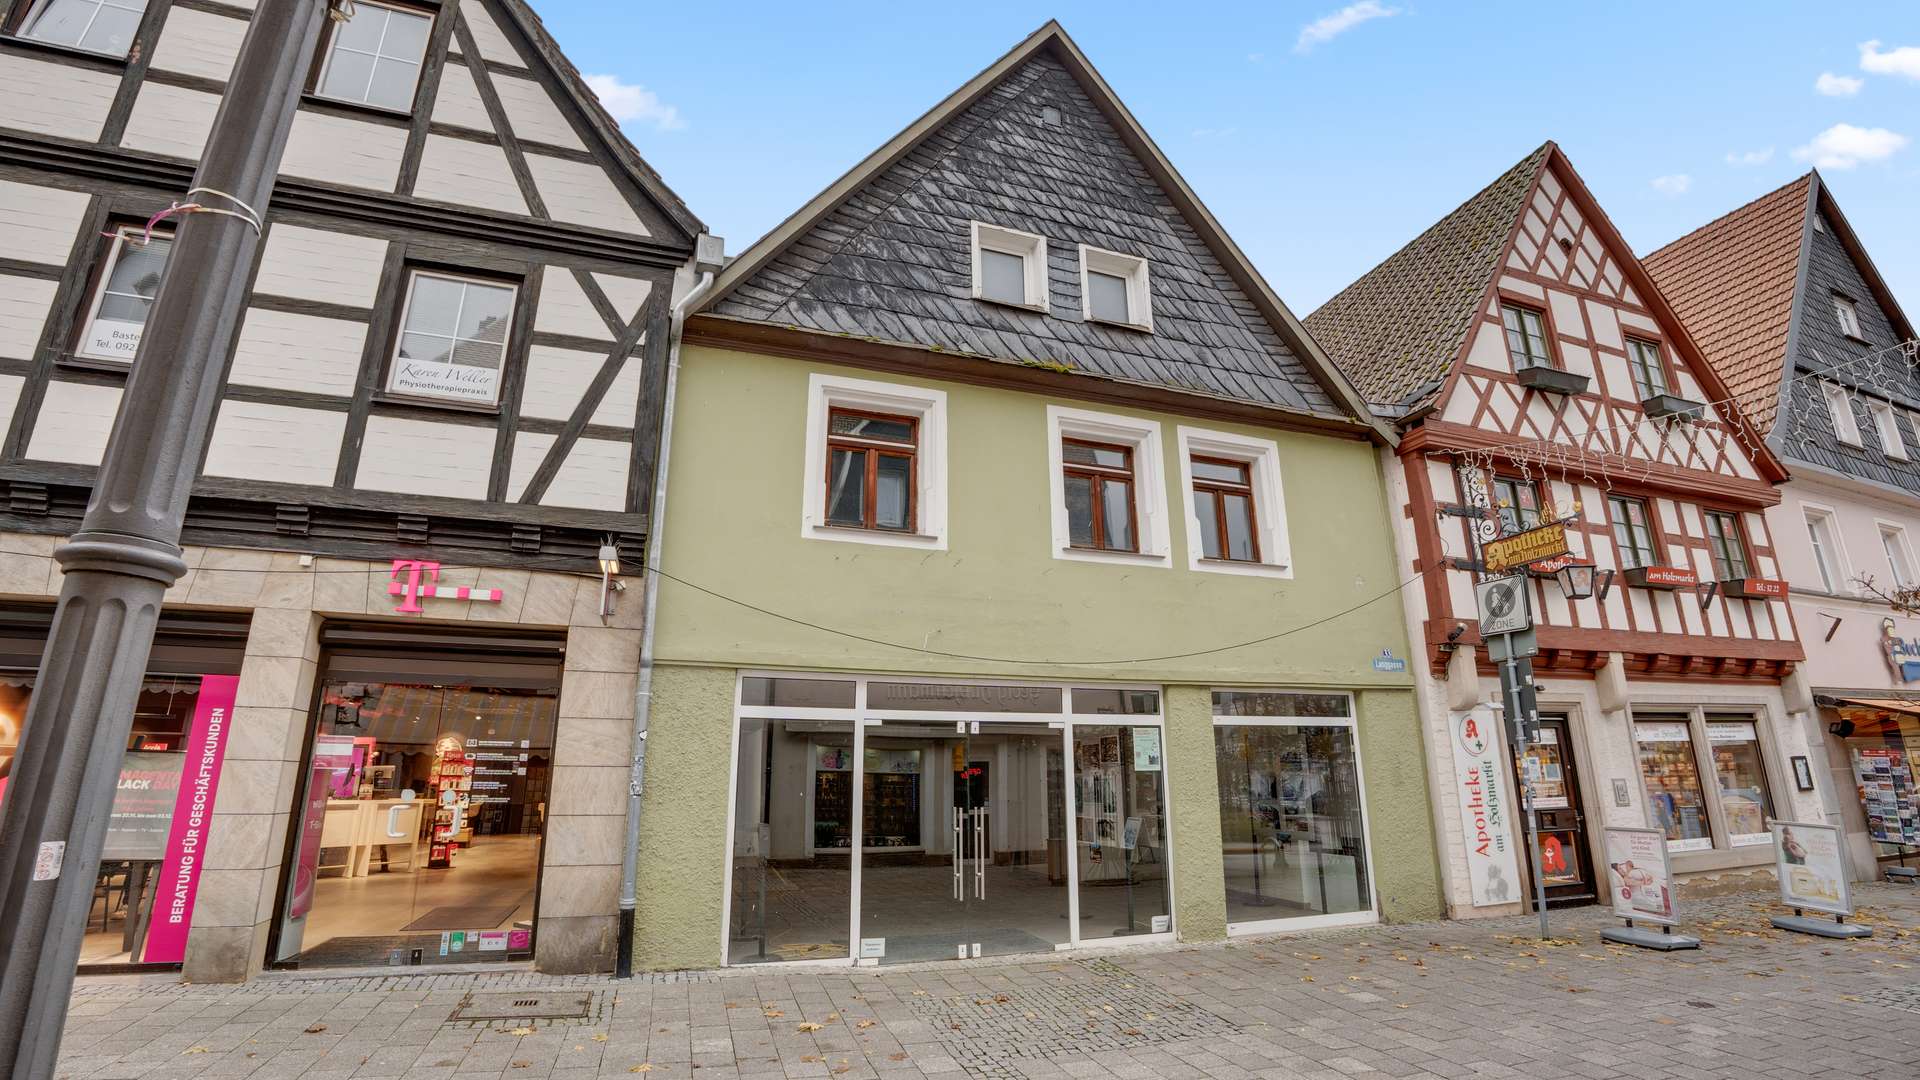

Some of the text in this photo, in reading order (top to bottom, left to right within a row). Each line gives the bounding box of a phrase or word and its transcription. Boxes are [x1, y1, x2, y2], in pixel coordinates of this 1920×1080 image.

[96, 339, 137, 351] Tel. 092
[401, 362, 492, 384] Karen Weller
[399, 378, 488, 396] Physiotherapiepraxis
[1486, 525, 1564, 571] Apotheke
[1663, 571, 1695, 583] Holzmarkt
[1491, 618, 1515, 631] ZONE
[117, 779, 151, 790] LACK
[169, 707, 225, 924] BERATUNG FÜR GESCHÄFTSKUNDEN
